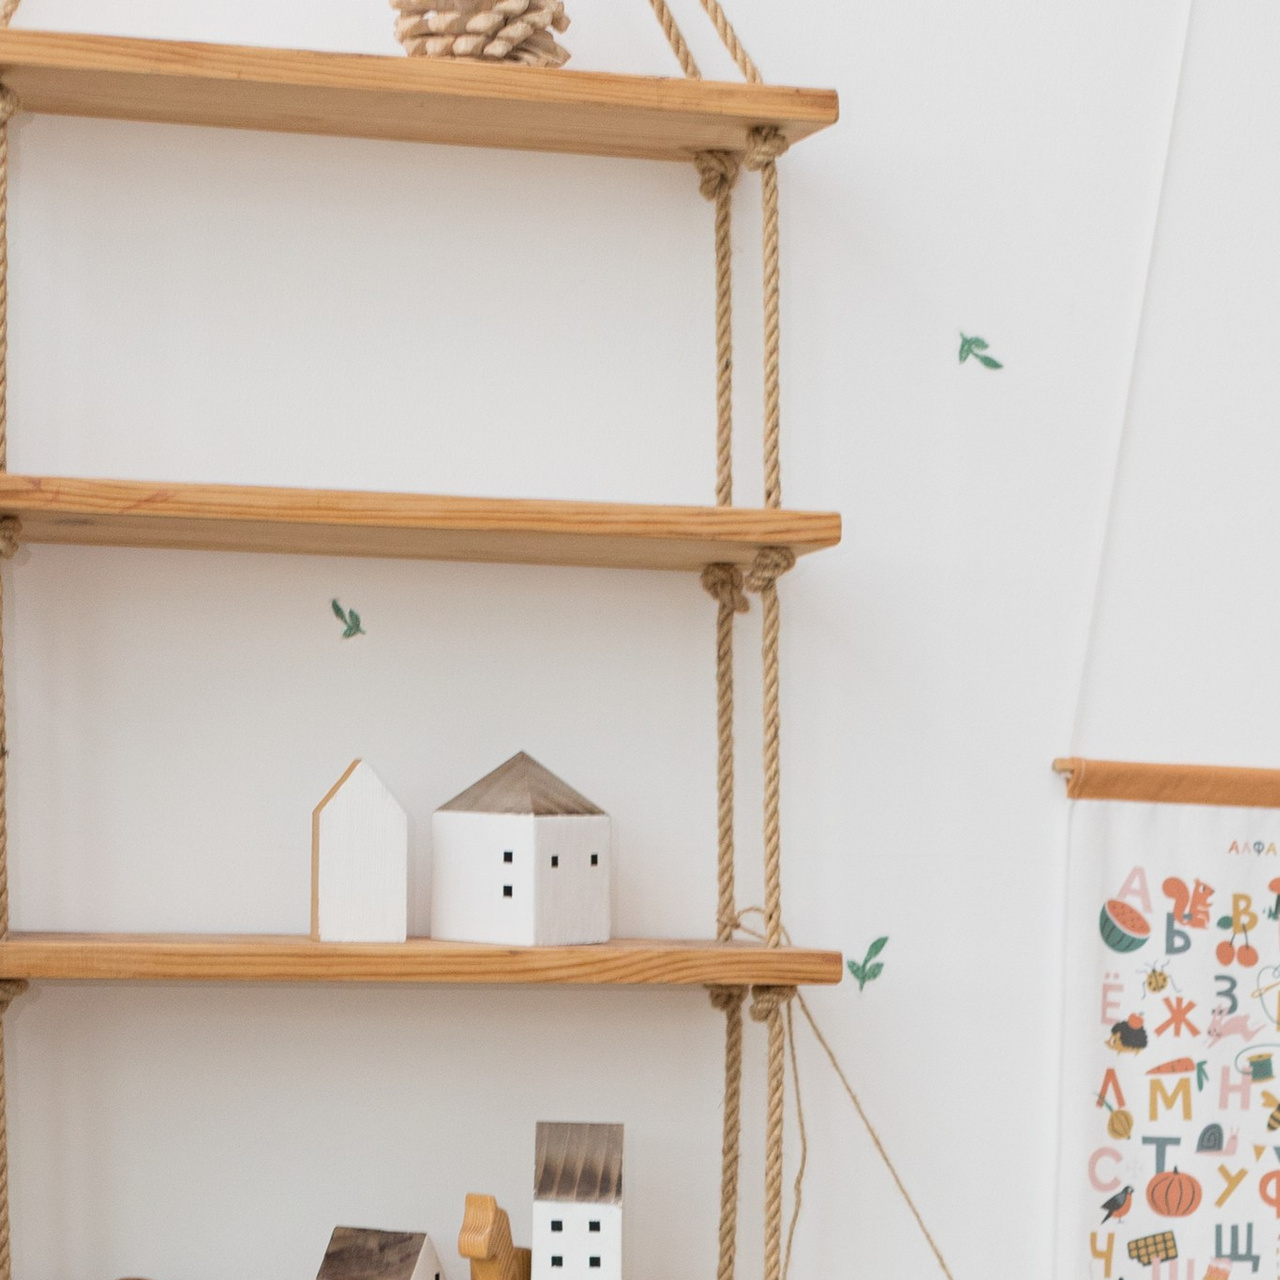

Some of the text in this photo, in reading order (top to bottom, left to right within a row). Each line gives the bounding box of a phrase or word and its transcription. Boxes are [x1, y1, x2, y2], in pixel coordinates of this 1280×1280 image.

[1117, 866, 1153, 914] А
[1232, 893, 1258, 935] В
[1100, 971, 1124, 1026] Ё
[1154, 996, 1201, 1038] Ж
[1096, 1067, 1126, 1109] Л
[1149, 1077, 1193, 1122] М
[1218, 1065, 1253, 1111] Н
[1088, 1146, 1123, 1193] С
[1141, 1136, 1182, 1174] Т
[1215, 1163, 1249, 1208] У
[1090, 1231, 1115, 1279] Ч
[1214, 1222, 1261, 1273] Щ
